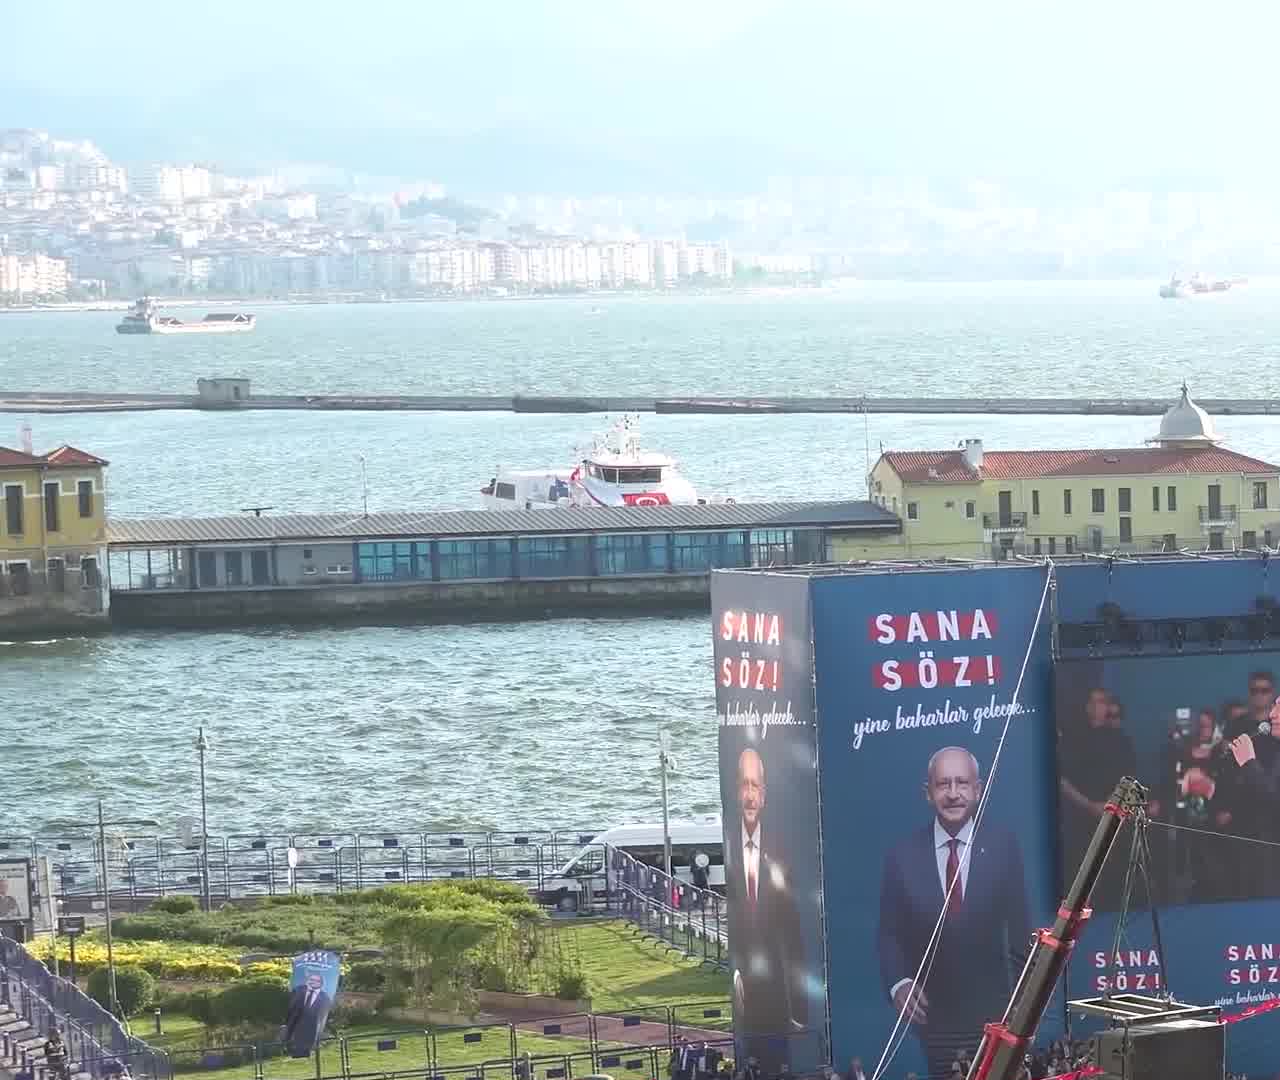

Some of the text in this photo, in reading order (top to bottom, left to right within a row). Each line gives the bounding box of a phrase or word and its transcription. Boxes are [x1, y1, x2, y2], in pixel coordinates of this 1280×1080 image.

[723, 611, 780, 645] SANA
[875, 609, 993, 645] SANA
[722, 651, 778, 692] SÖZ!
[881, 651, 996, 692] SÖZ!
[727, 700, 806, 739] baharlar gelecek...
[853, 694, 1036, 750] yine baharlar gelecek...
[1095, 950, 1160, 968] SANA
[1097, 971, 1160, 991] SÖZ!
